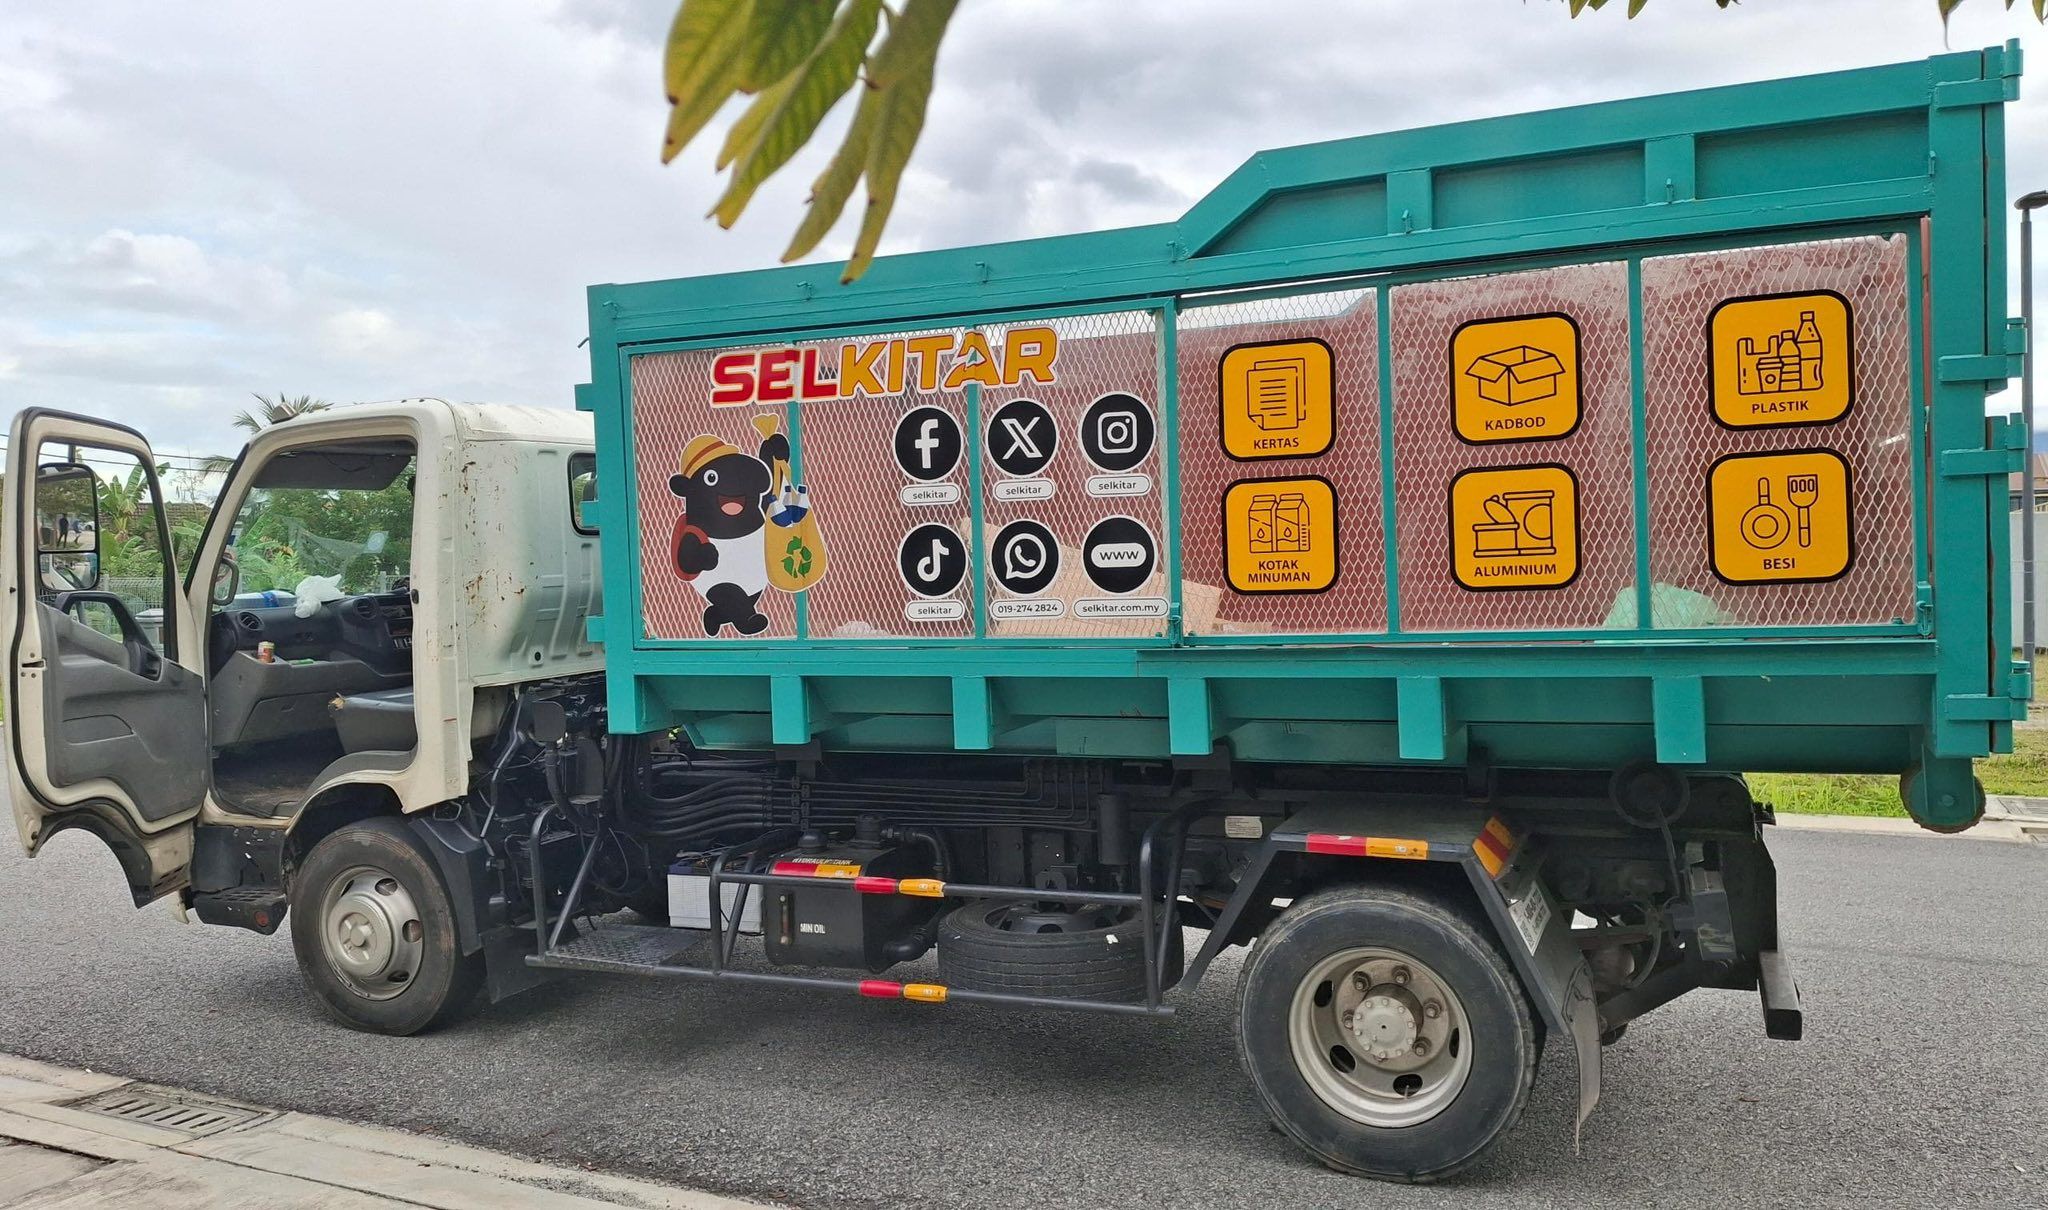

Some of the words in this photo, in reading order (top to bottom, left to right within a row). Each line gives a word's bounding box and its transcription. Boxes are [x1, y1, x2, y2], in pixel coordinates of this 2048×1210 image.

[711, 327, 1058, 404] SELKITAR
[1752, 400, 1809, 414] PLASTIK
[1485, 416, 1546, 431] KADBOD
[1253, 437, 1299, 449] KERTAS
[1005, 485, 1042, 495] selkitar
[1098, 480, 1136, 491] selkitar
[913, 489, 947, 500] selkitar
[1099, 550, 1139, 561] www
[1258, 559, 1299, 570] KOTAK
[1763, 557, 1796, 570] BESI
[1474, 563, 1557, 577] ALUMINIUM
[1247, 572, 1311, 583] MINUMAN
[917, 605, 952, 615] selkitar
[997, 604, 1033, 614] 019-274
[1034, 603, 1058, 613] 2824
[1082, 602, 1160, 615] selkitar.com.my
[814, 924, 826, 934] OIL
